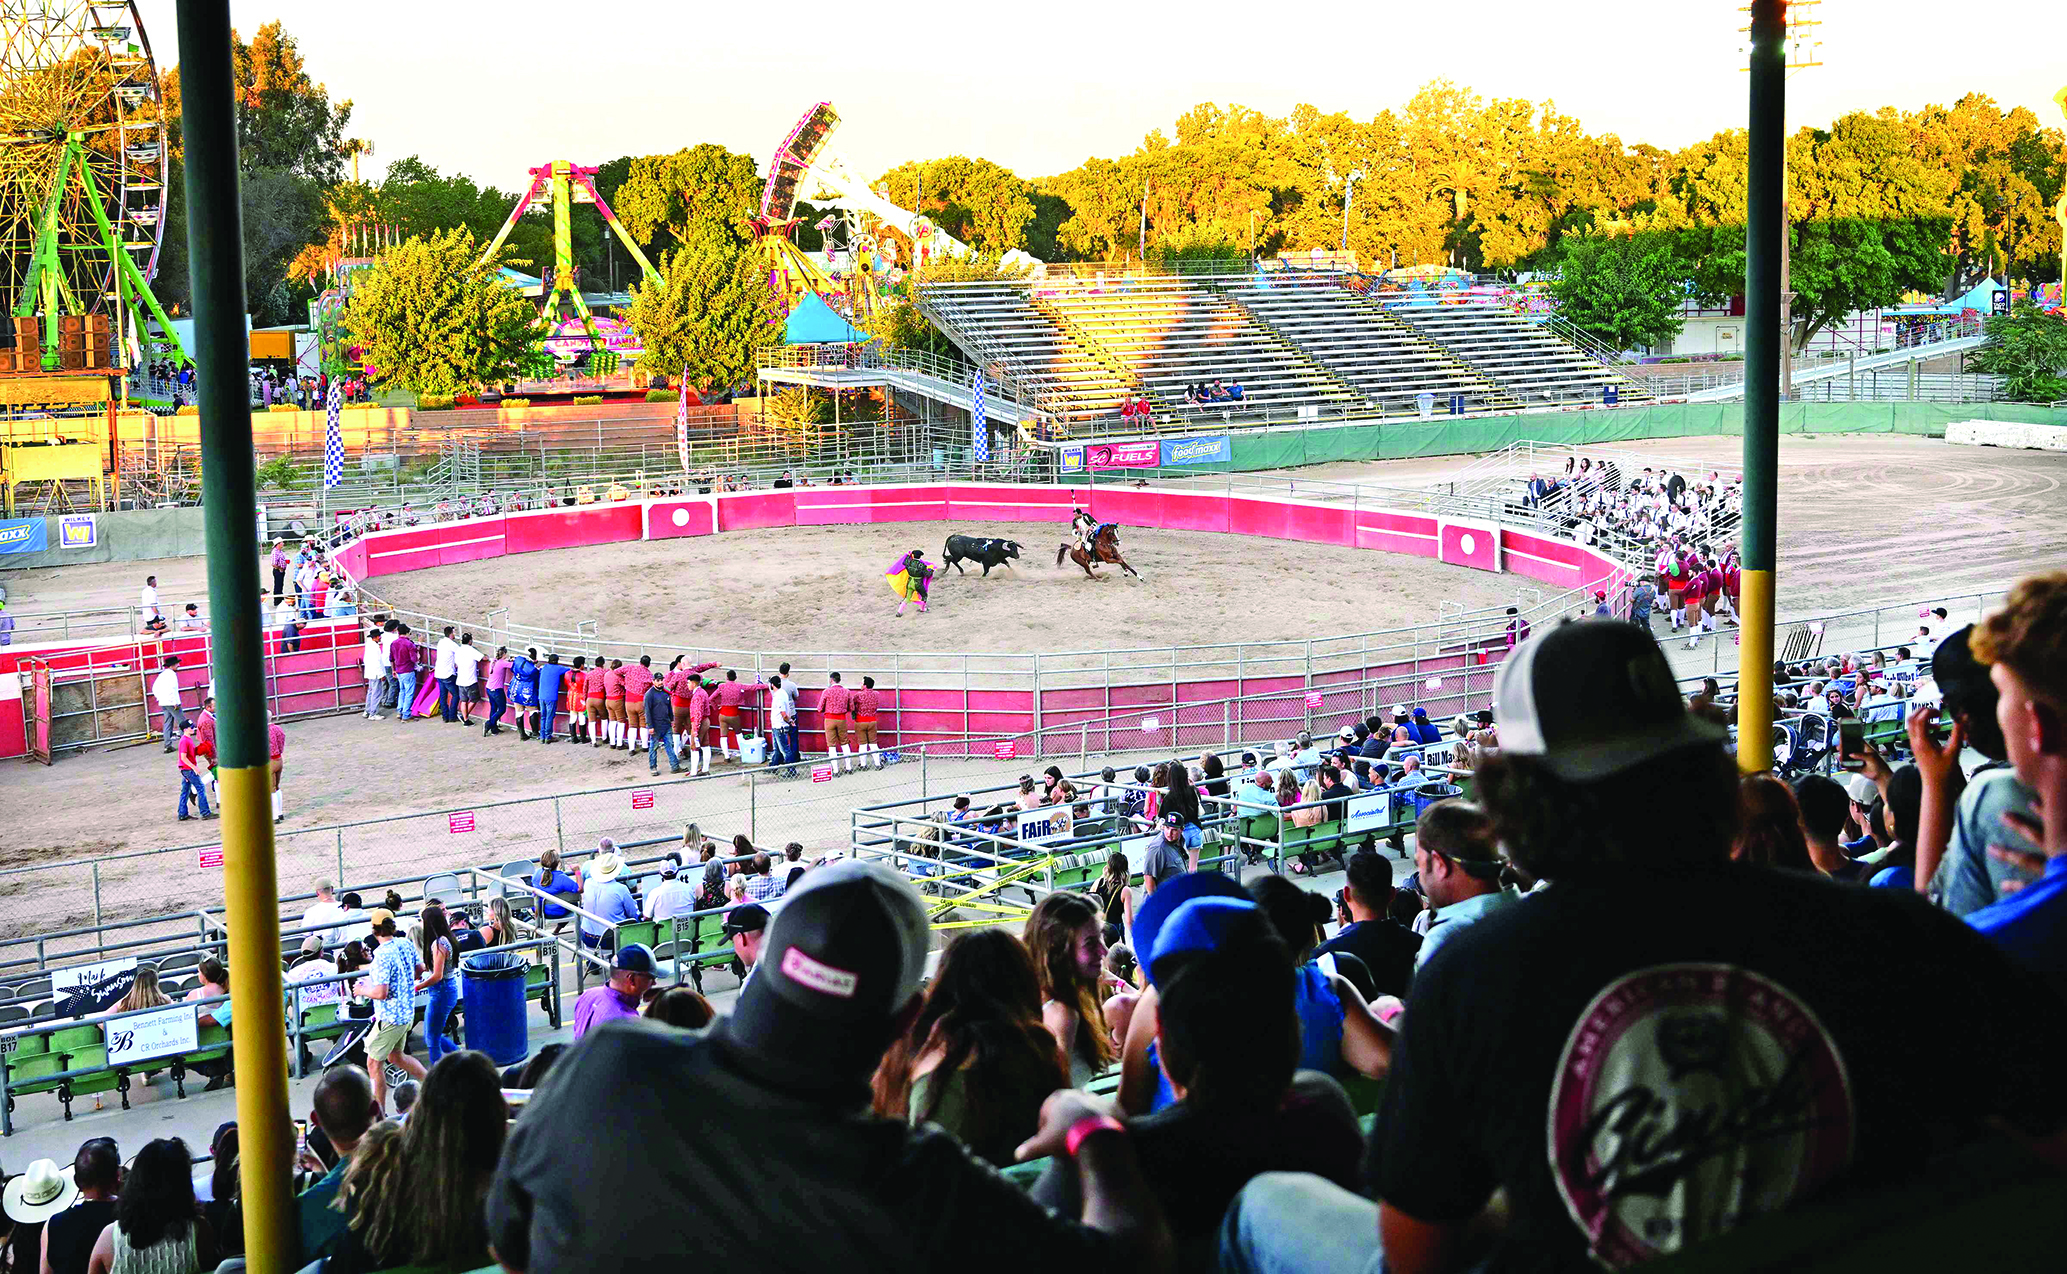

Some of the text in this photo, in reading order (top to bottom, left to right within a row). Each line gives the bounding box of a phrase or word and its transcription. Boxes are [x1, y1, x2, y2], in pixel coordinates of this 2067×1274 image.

[555, 339, 590, 347] CANDY
[1111, 452, 1153, 462] FUELS
[0, 528, 26, 541] axx
[1427, 752, 1440, 767] Bill
[1351, 806, 1386, 819] Associated
[997, 868, 1035, 887] CAUTION CUIDADO
[468, 908, 482, 916] A16
[676, 922, 689, 932] B15
[542, 945, 557, 956] B16
[77, 968, 106, 985] Mark
[91, 974, 135, 1003] Swanson
[133, 1012, 195, 1031] Bennett Farming Inc.
[162, 1028, 168, 1037] &
[0, 1041, 17, 1053] B17
[140, 1036, 192, 1053] CR Orchards Inc.
